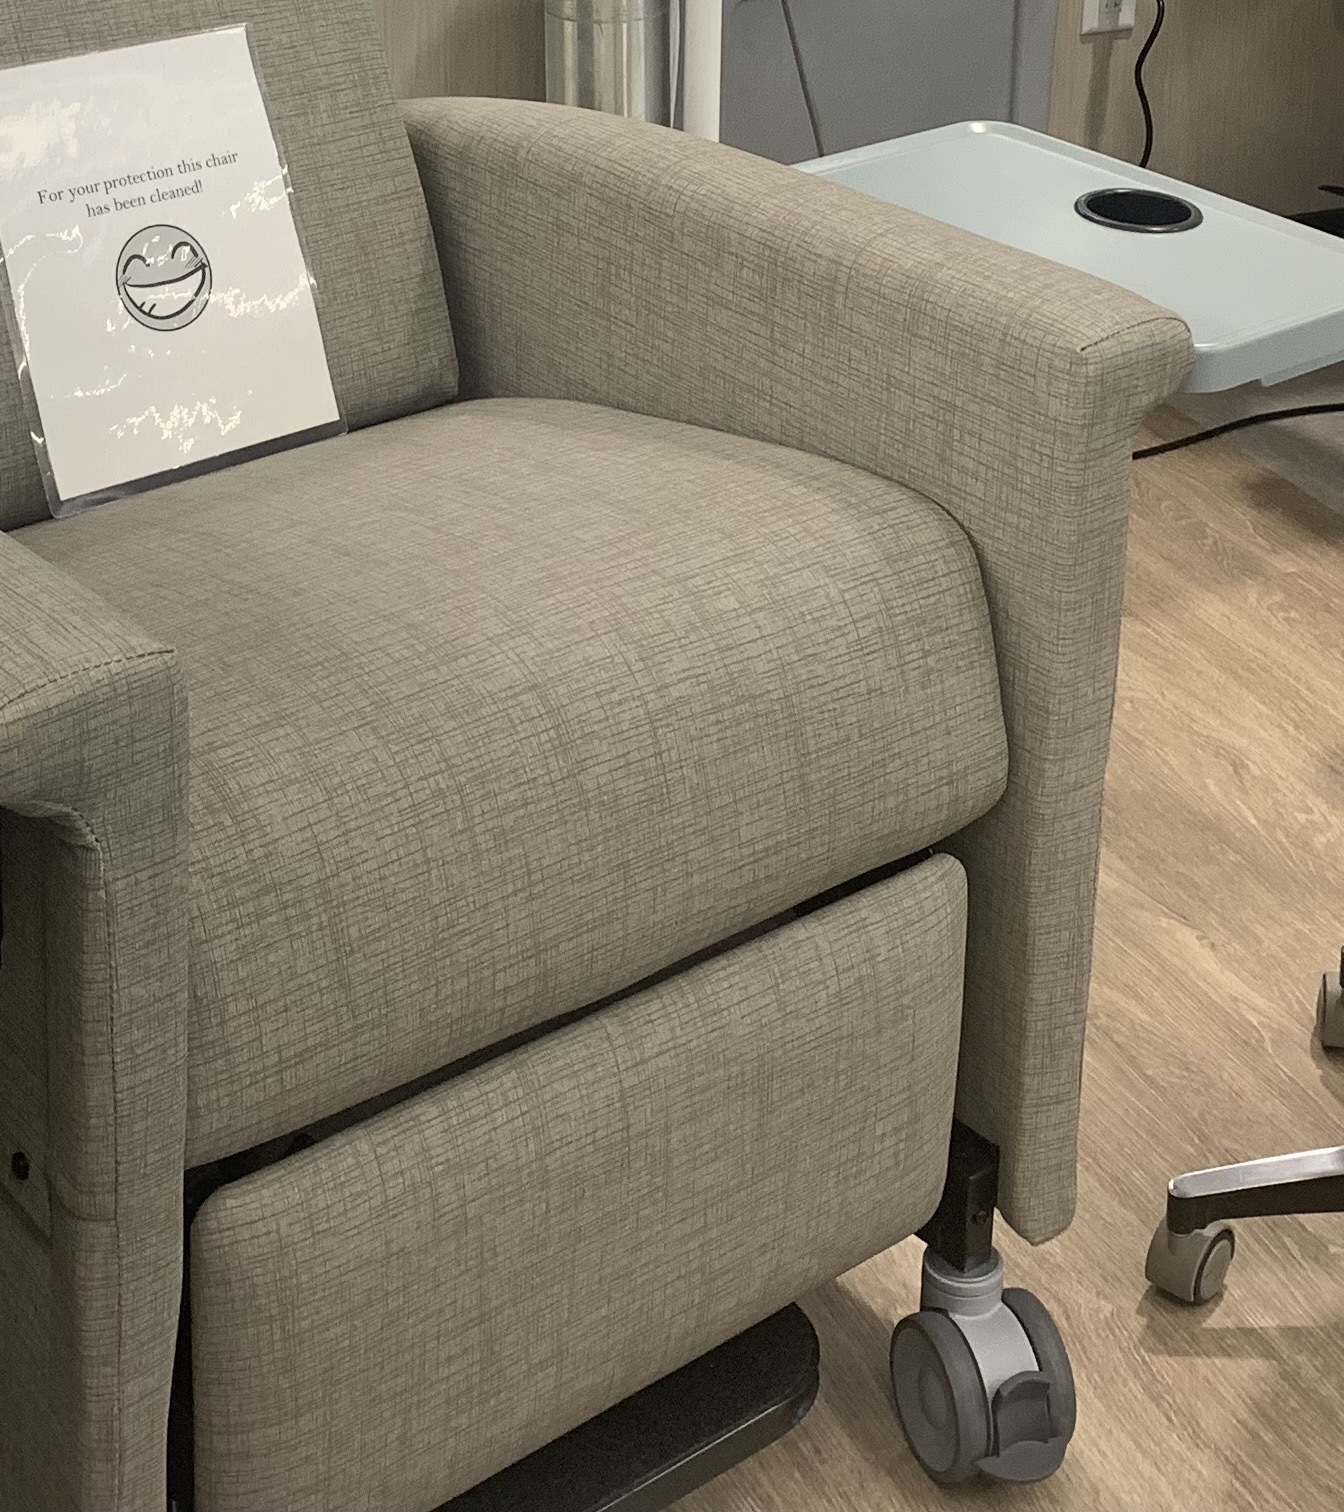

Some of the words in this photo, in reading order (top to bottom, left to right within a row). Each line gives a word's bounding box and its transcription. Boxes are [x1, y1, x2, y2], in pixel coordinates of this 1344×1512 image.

[37, 188, 64, 205] For
[69, 182, 100, 203] your
[103, 166, 174, 194] protection
[177, 158, 202, 175] this
[205, 150, 238, 169] chair
[85, 203, 110, 218] has
[113, 196, 146, 212] been
[150, 179, 204, 204] cleaned!
